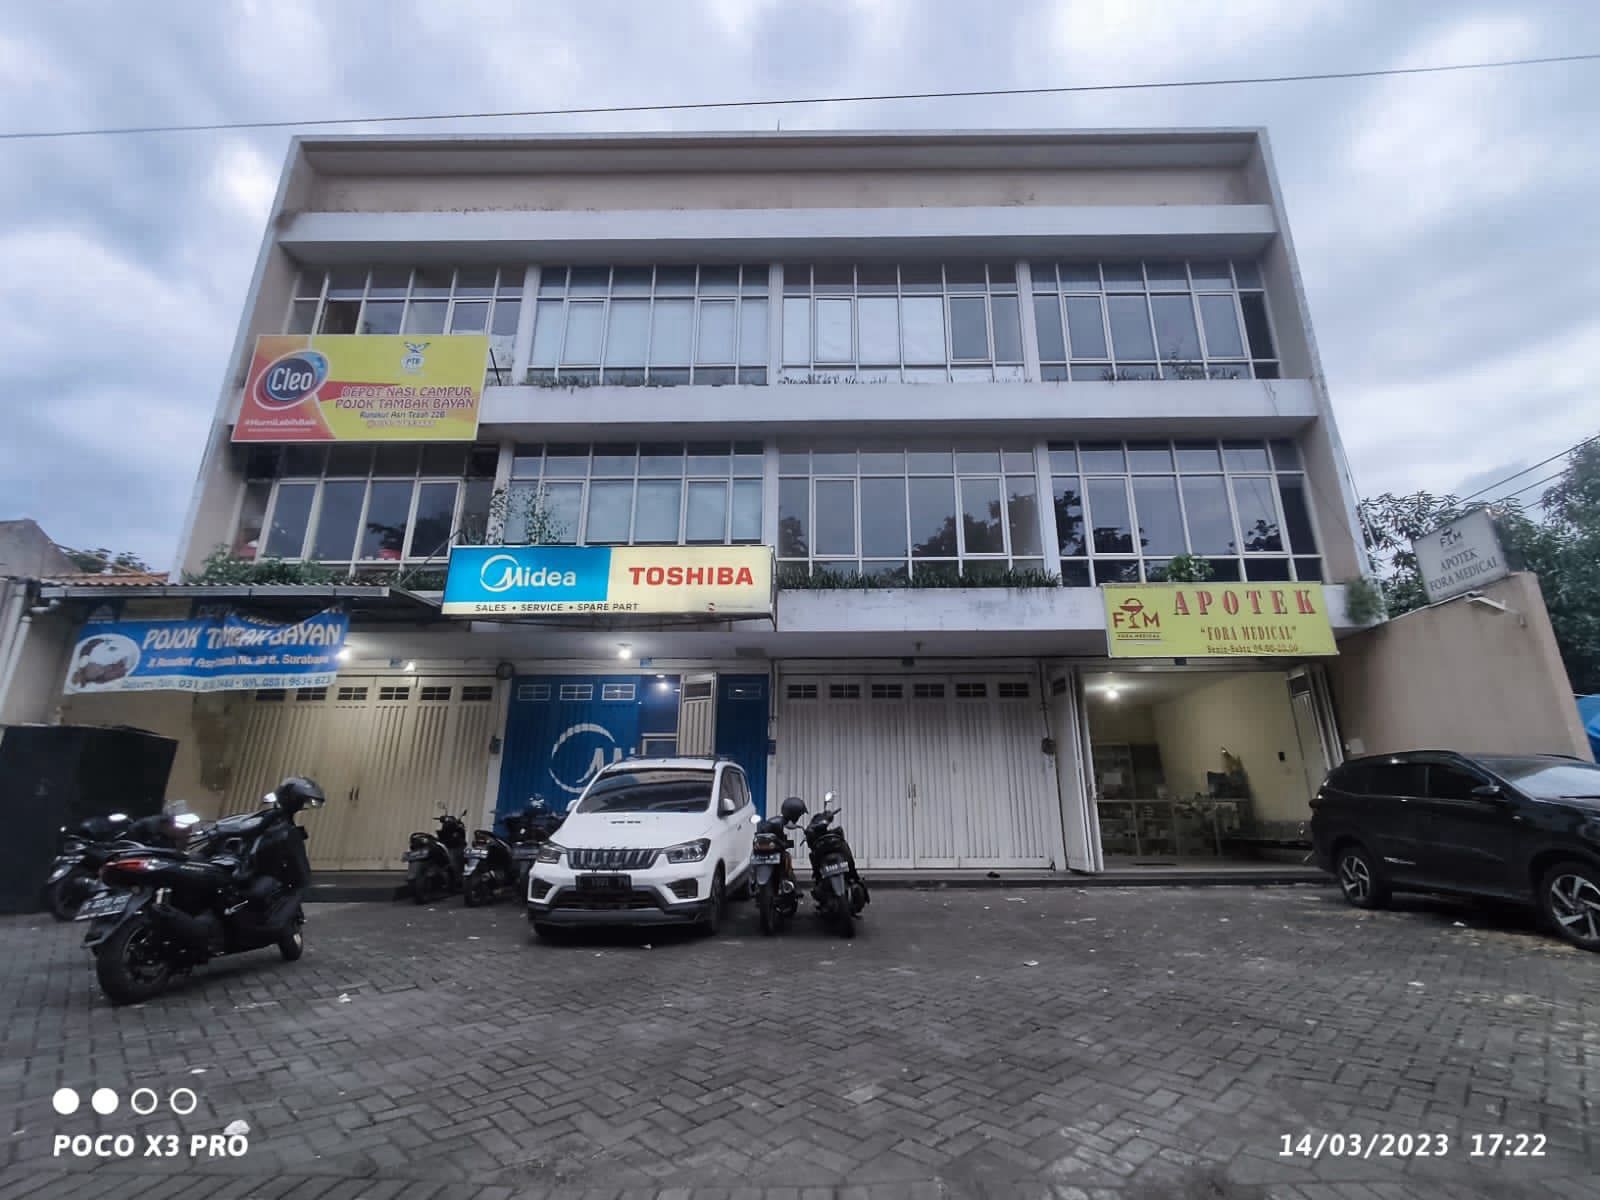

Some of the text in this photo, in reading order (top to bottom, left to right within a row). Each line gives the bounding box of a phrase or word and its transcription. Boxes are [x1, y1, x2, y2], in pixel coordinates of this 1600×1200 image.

[271, 367, 313, 391] Cleo
[342, 386, 472, 397] DEPOT NASI CAMPUR
[335, 399, 474, 409] POJOK TAMBAK BAYAN
[1441, 550, 1479, 570] APOTEK
[496, 562, 577, 589] Midea
[629, 567, 754, 586] TOSHIBA
[1430, 555, 1497, 591] FORA MEDICAL
[475, 602, 639, 612] SALES SERVICE SPARE PART
[1173, 590, 1317, 616] APOTEK
[142, 627, 202, 650] POJOK
